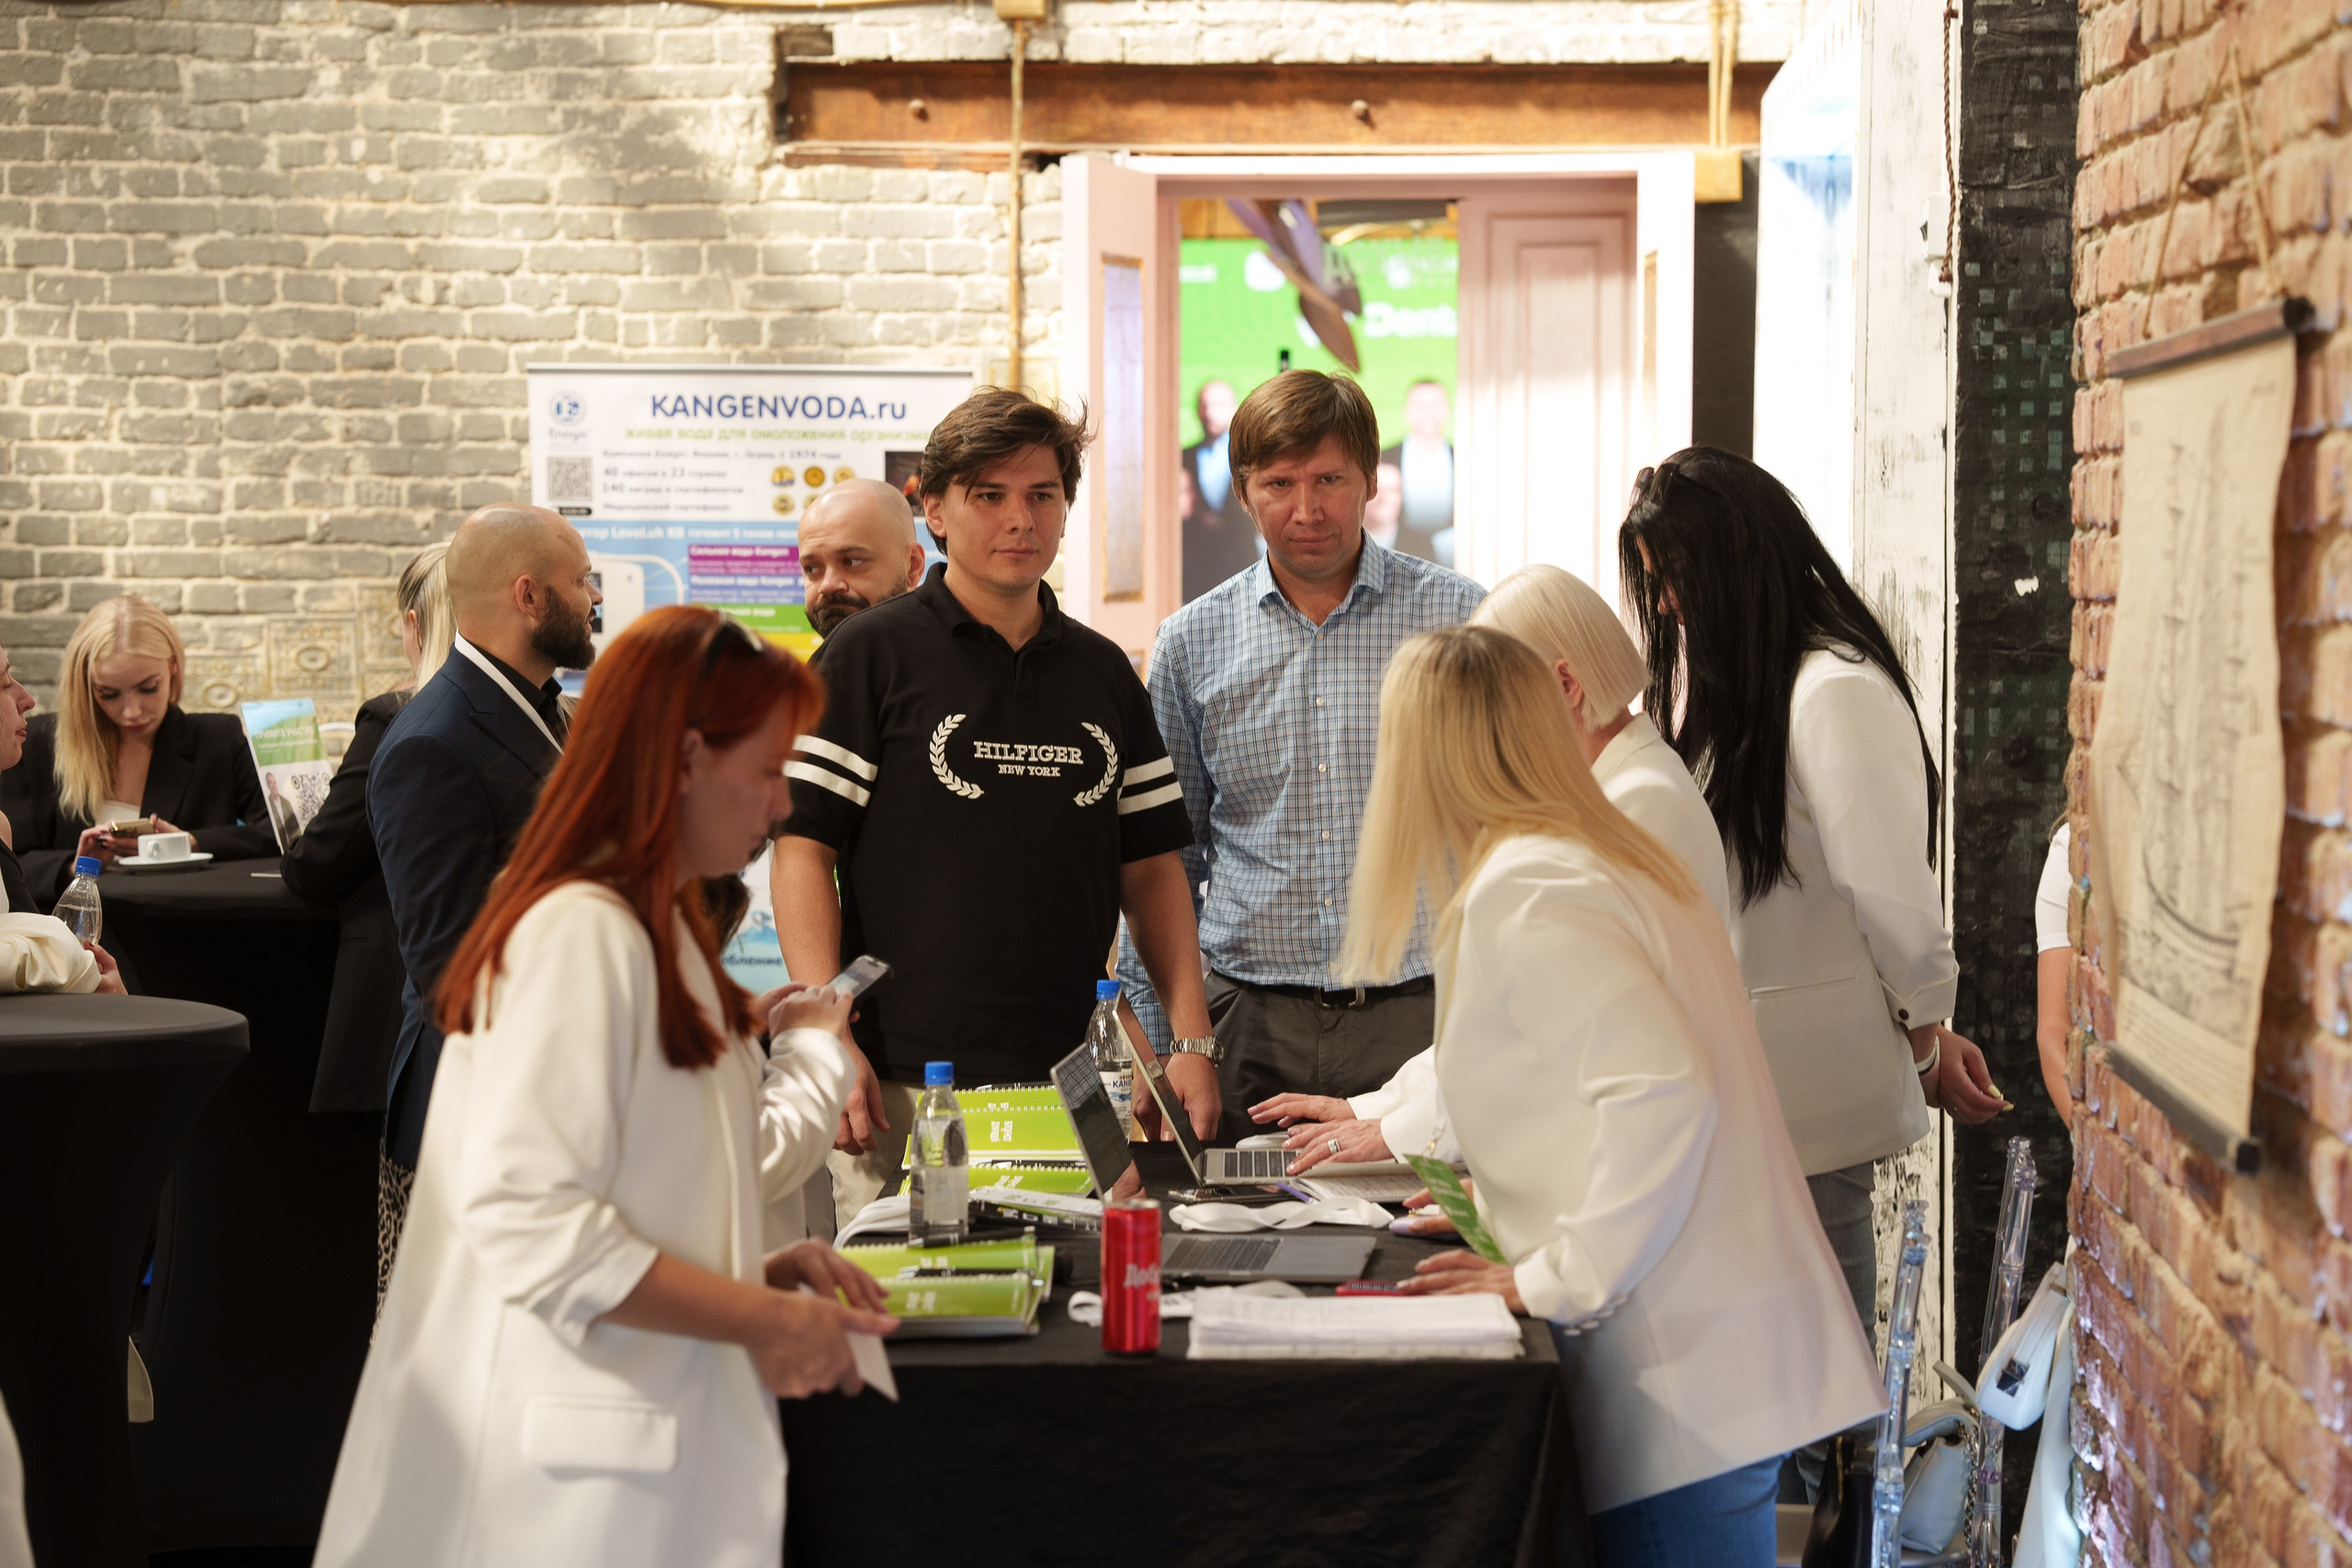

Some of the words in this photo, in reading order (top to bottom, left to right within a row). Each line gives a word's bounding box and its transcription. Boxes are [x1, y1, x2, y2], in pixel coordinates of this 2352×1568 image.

[652, 395, 907, 419] KANGENVODA.ru
[627, 428, 672, 439] живая
[677, 429, 713, 440] вода
[718, 428, 746, 441] для
[751, 429, 845, 440] омоложения
[605, 468, 619, 477] 40
[973, 740, 1084, 765] HILFIGER
[998, 764, 1024, 775] NEW
[1026, 765, 1061, 777] YORK
